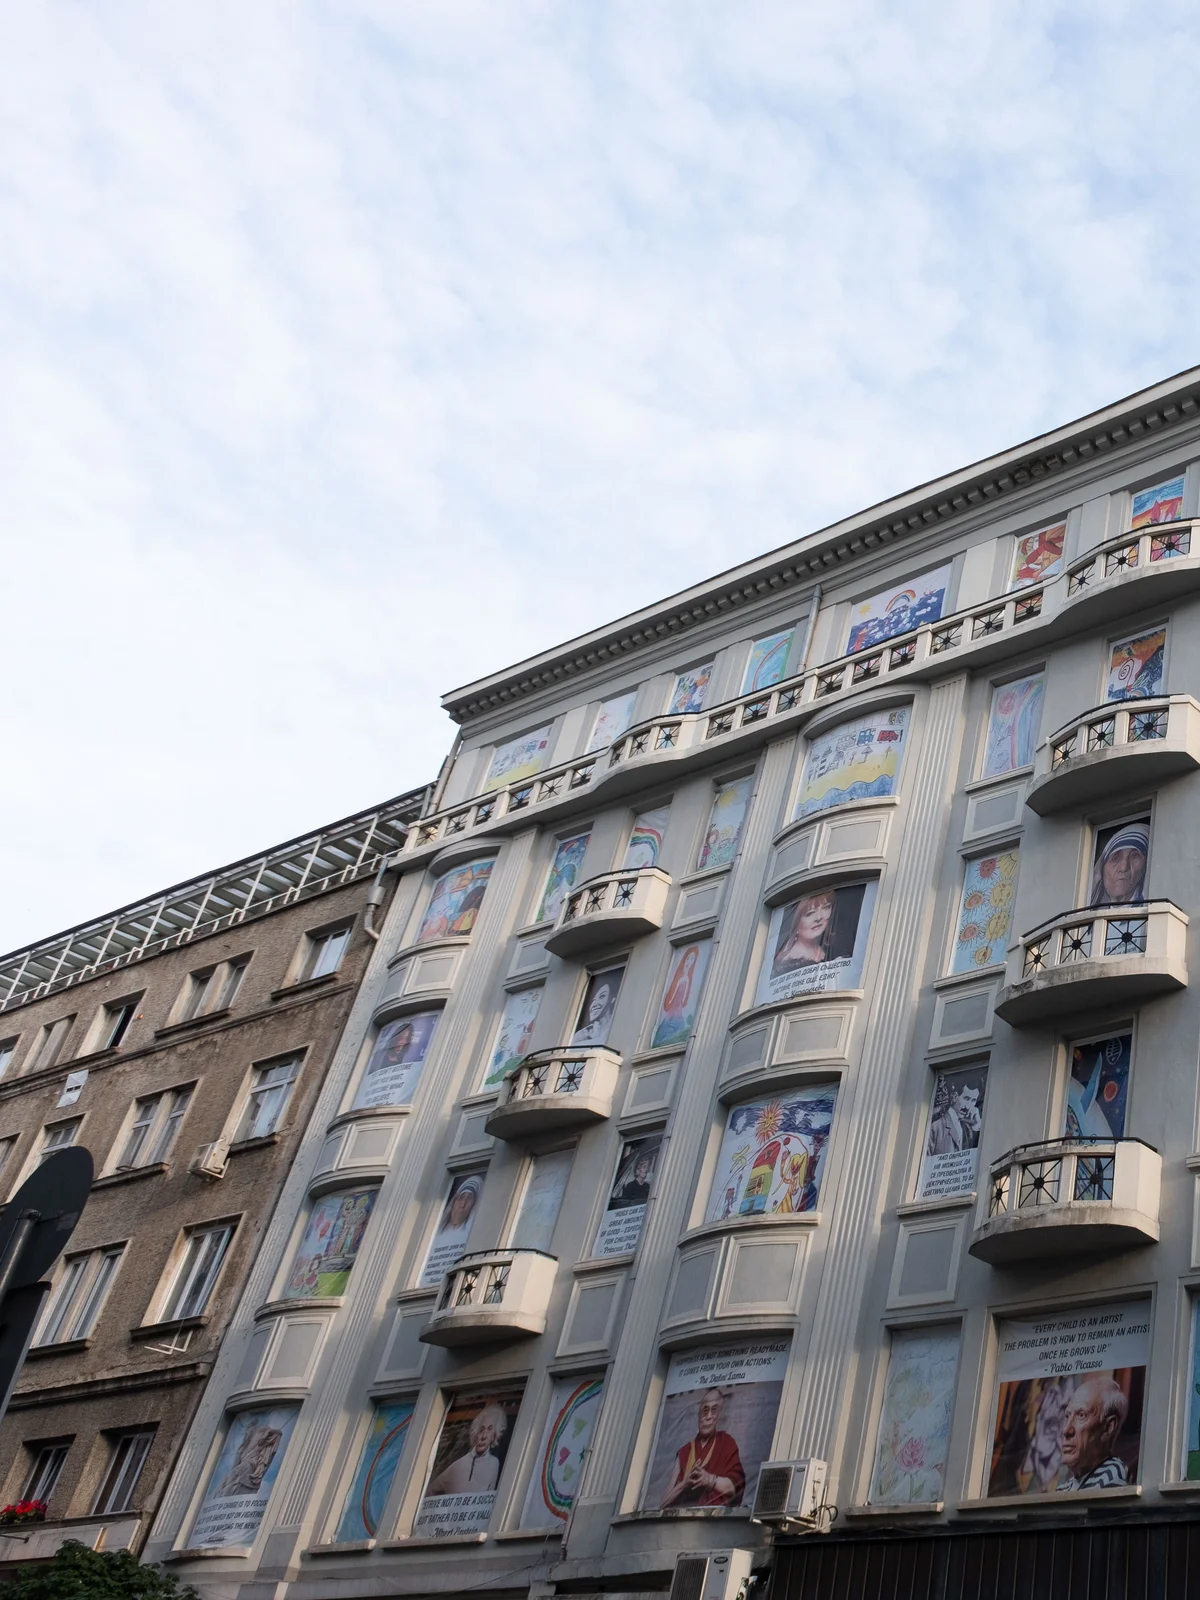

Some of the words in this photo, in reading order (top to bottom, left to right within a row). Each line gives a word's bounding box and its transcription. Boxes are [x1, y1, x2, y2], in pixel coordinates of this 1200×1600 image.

[1058, 1320, 1077, 1331] CHILD
[1079, 1318, 1086, 1327] IS
[1088, 1317, 1098, 1326] AN
[1099, 1314, 1124, 1325] ARTIST.
[1004, 1342, 1016, 1352] THE
[1018, 1338, 1049, 1349] PROBLEM
[1050, 1336, 1057, 1345] IS
[1059, 1334, 1075, 1344] HOW
[1078, 1333, 1086, 1342] TO
[1088, 1329, 1115, 1340] REMAIN
[1116, 1327, 1125, 1336] AN
[717, 1348, 749, 1358] SOMETHING
[1039, 1351, 1057, 1361] ONCE
[1059, 1349, 1069, 1359] HE
[1070, 1346, 1096, 1357] GROWS
[684, 1366, 700, 1376] COMES
[700, 1364, 715, 1372] FROM
[731, 1360, 744, 1368] OWN
[1050, 1362, 1072, 1373] Pablo
[1075, 1360, 1103, 1370] Picasso
[440, 1498, 455, 1507] NOT
[454, 1497, 462, 1506] TO
[462, 1496, 472, 1506] BE
[472, 1496, 477, 1505] A
[428, 1514, 450, 1524] RATHER
[452, 1512, 458, 1521] TO
[459, 1512, 468, 1521] BE
